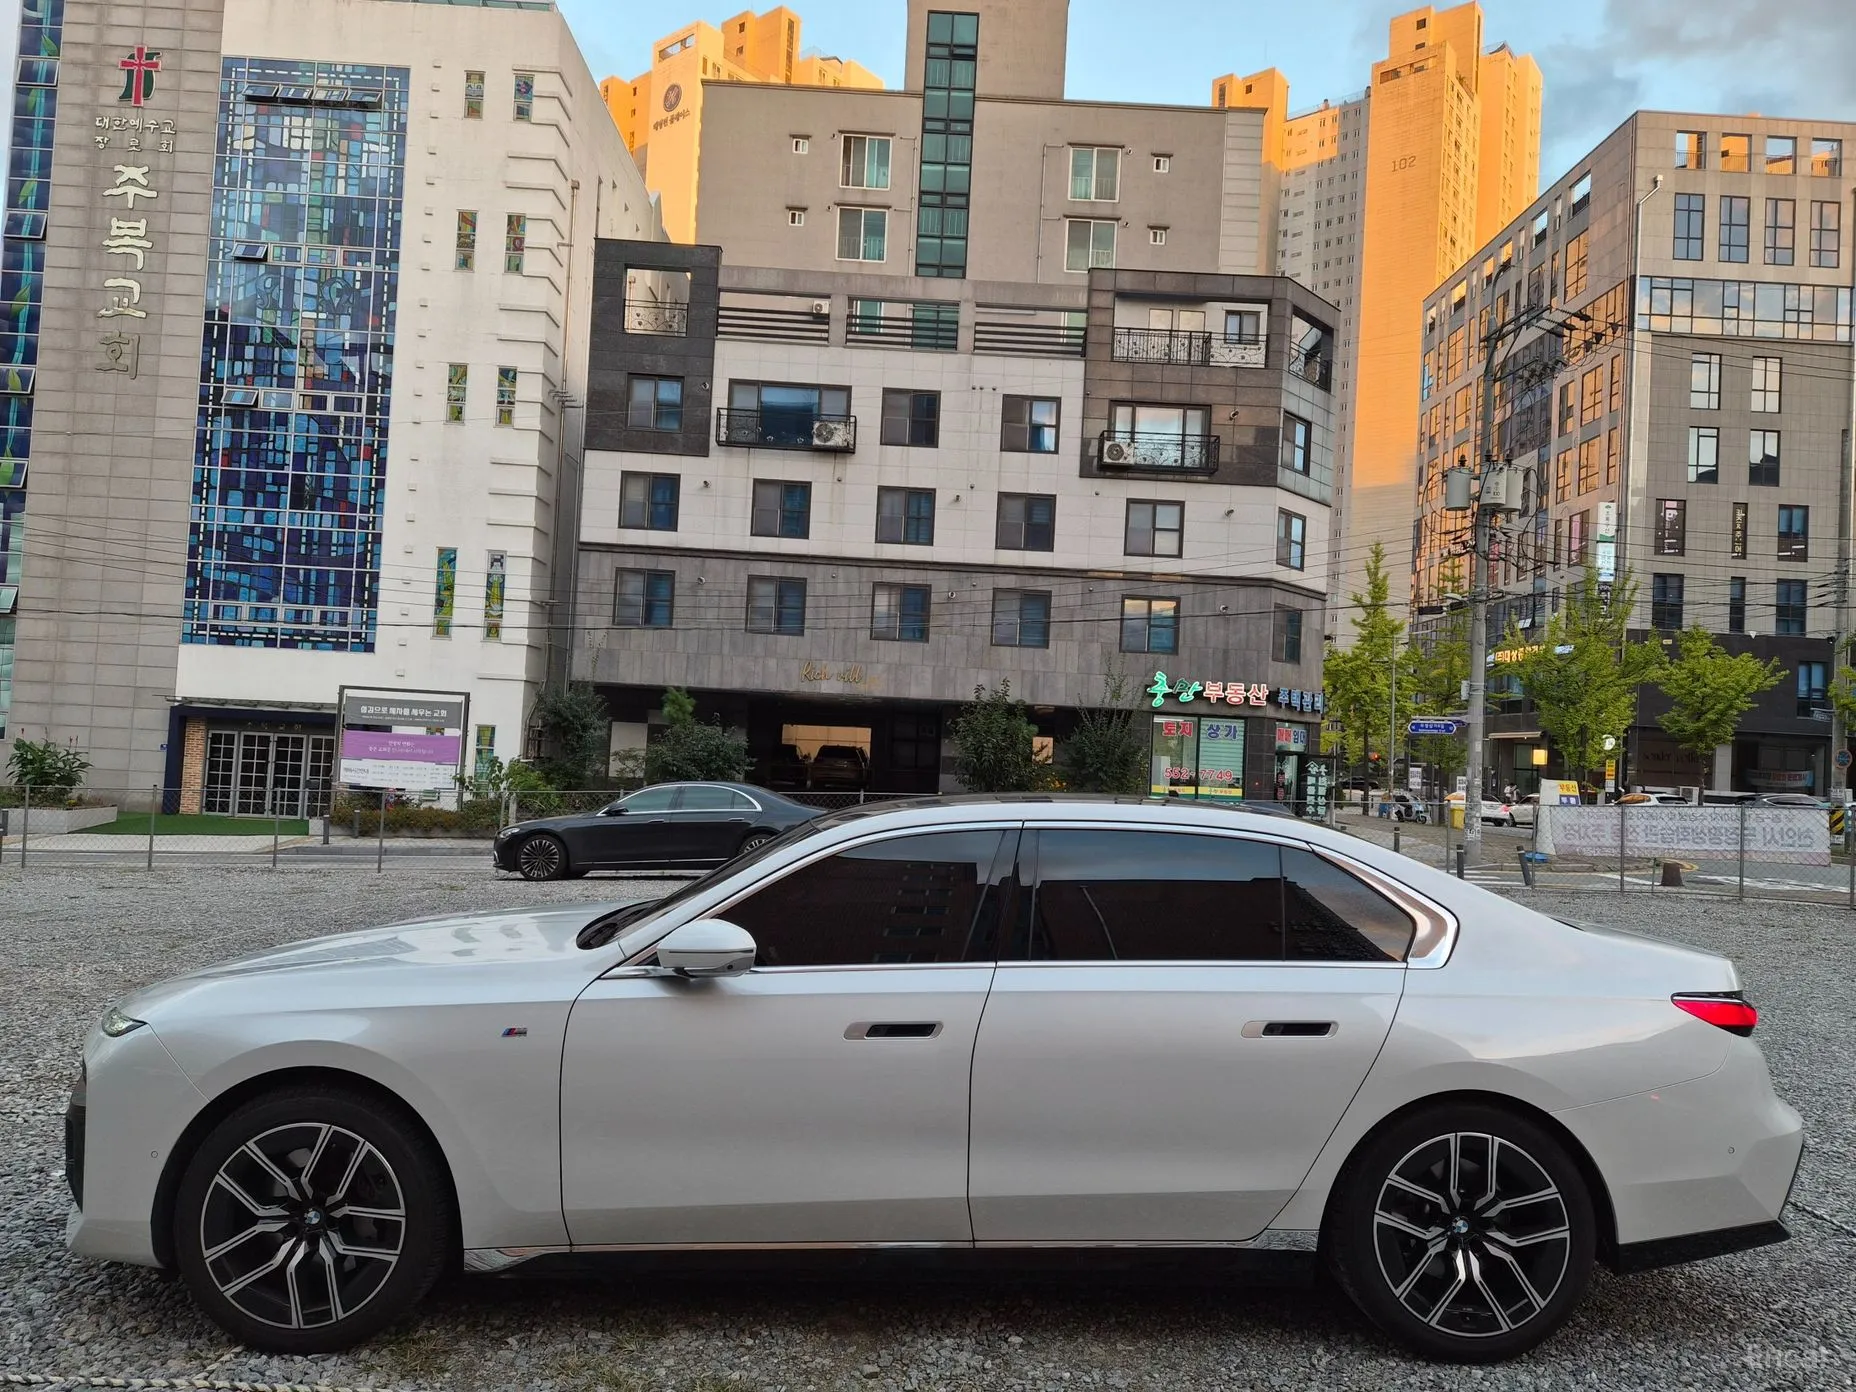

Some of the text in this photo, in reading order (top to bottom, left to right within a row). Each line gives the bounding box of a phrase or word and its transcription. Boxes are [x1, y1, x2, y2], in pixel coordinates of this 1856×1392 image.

[94, 115, 177, 136] 대한예수교
[94, 135, 174, 154] 장로회
[1391, 155, 1417, 173] 102
[1147, 671, 1203, 707] 충만
[1203, 681, 1269, 706] 부동산
[433, 708, 448, 718] 교회
[1162, 721, 1194, 738] 토지
[1207, 723, 1238, 740] 상가
